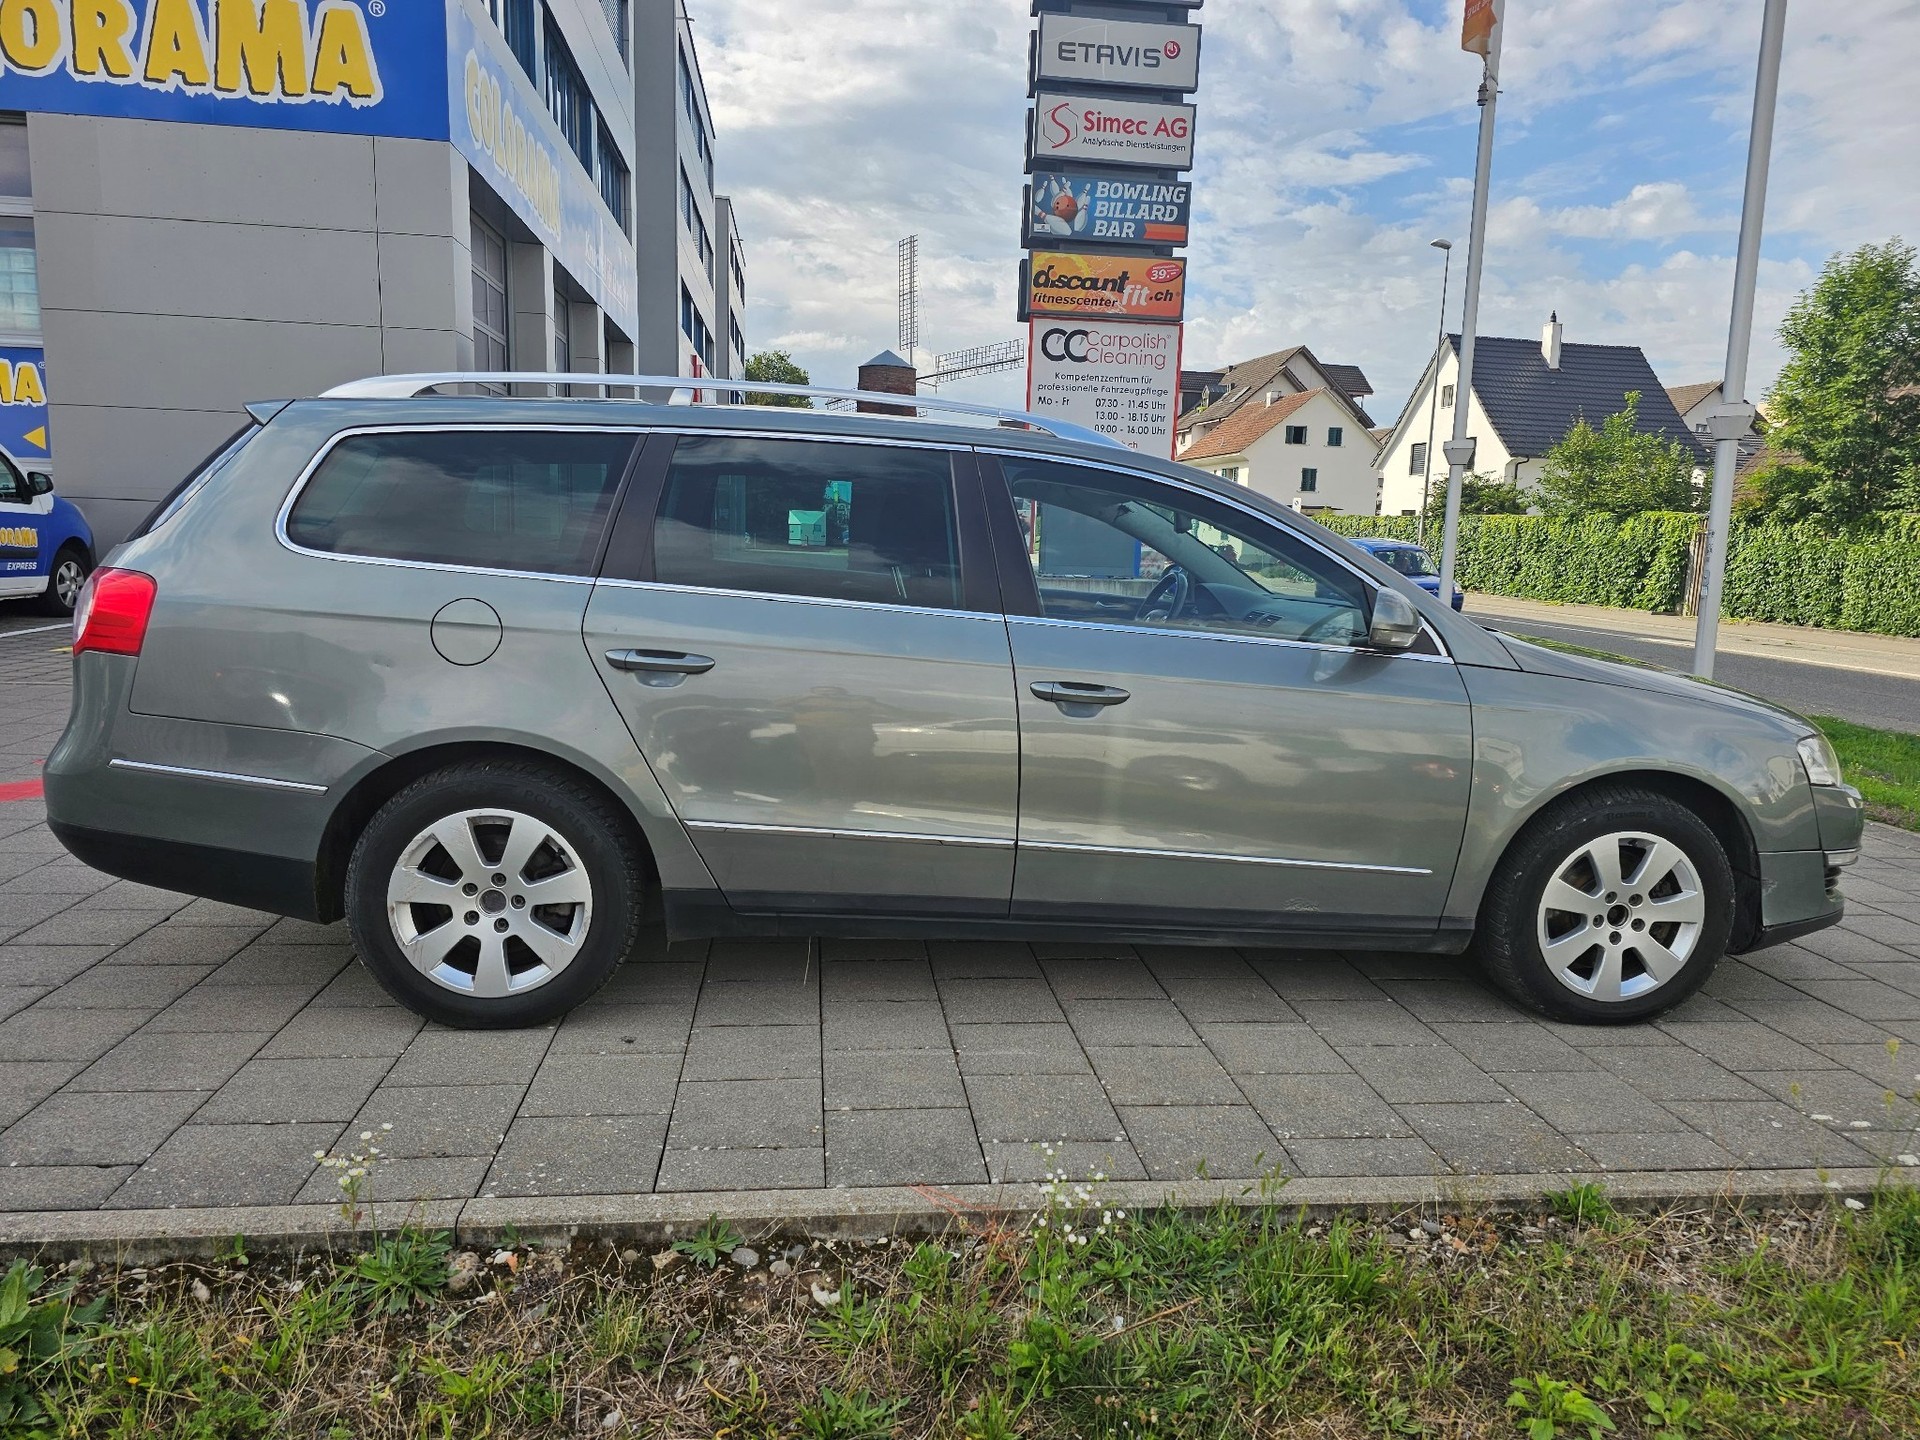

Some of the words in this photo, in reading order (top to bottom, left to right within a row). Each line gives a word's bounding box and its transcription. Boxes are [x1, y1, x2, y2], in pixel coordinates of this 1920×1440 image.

[1057, 41, 1161, 68] ETAVIS
[1083, 110, 1148, 136] Simec
[1152, 117, 1188, 139] AG
[465, 48, 561, 242] COLORAMA
[1082, 136, 1124, 149] Analytische
[1126, 139, 1186, 153] Dienstleistungen
[1095, 181, 1187, 204] BOWLING
[1094, 201, 1179, 222] BILLARD
[1092, 220, 1136, 238] BAR
[1032, 292, 1119, 308] fitnesscenter
[1086, 348, 1167, 370] Cleaning
[1055, 372, 1139, 384] Kompetenzzentrum
[1141, 375, 1153, 384] für
[1037, 382, 1099, 394] professionelle
[1101, 385, 1169, 397] Fahrzeugpflege
[1037, 396, 1053, 406] Mo
[1062, 397, 1070, 406] Fr
[1095, 398, 1119, 408] 07.30
[1128, 399, 1149, 410] 11.45
[1151, 401, 1166, 410] Uhr
[1095, 411, 1119, 421] 13.00
[1128, 412, 1149, 422] 18.15
[1151, 413, 1166, 423] Uhr
[1127, 425, 1149, 435] 16.00
[1151, 426, 1166, 435] Uhr
[6, 561, 38, 571] EXPRESS
